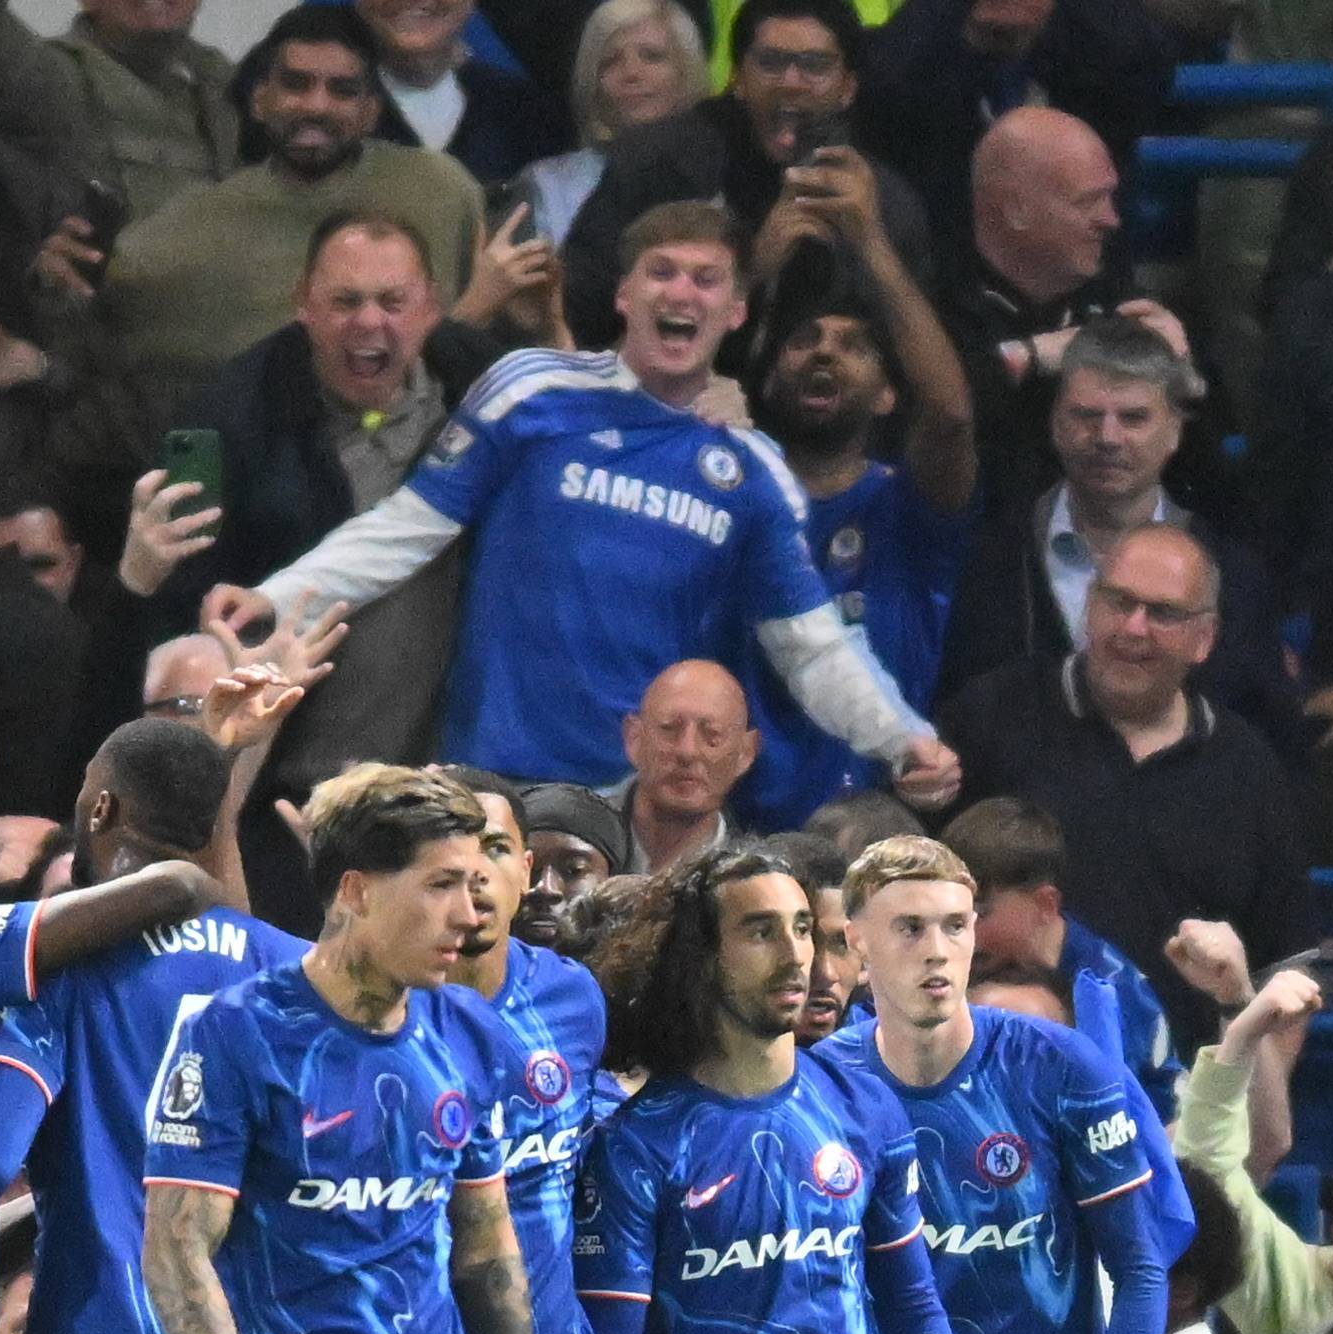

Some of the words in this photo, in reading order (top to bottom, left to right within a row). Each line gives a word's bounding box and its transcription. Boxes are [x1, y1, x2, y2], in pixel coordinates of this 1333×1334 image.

[560, 462, 733, 545] SAMSUNG
[680, 1225, 861, 1281] DAMAC
[922, 1213, 1044, 1255] MAC
